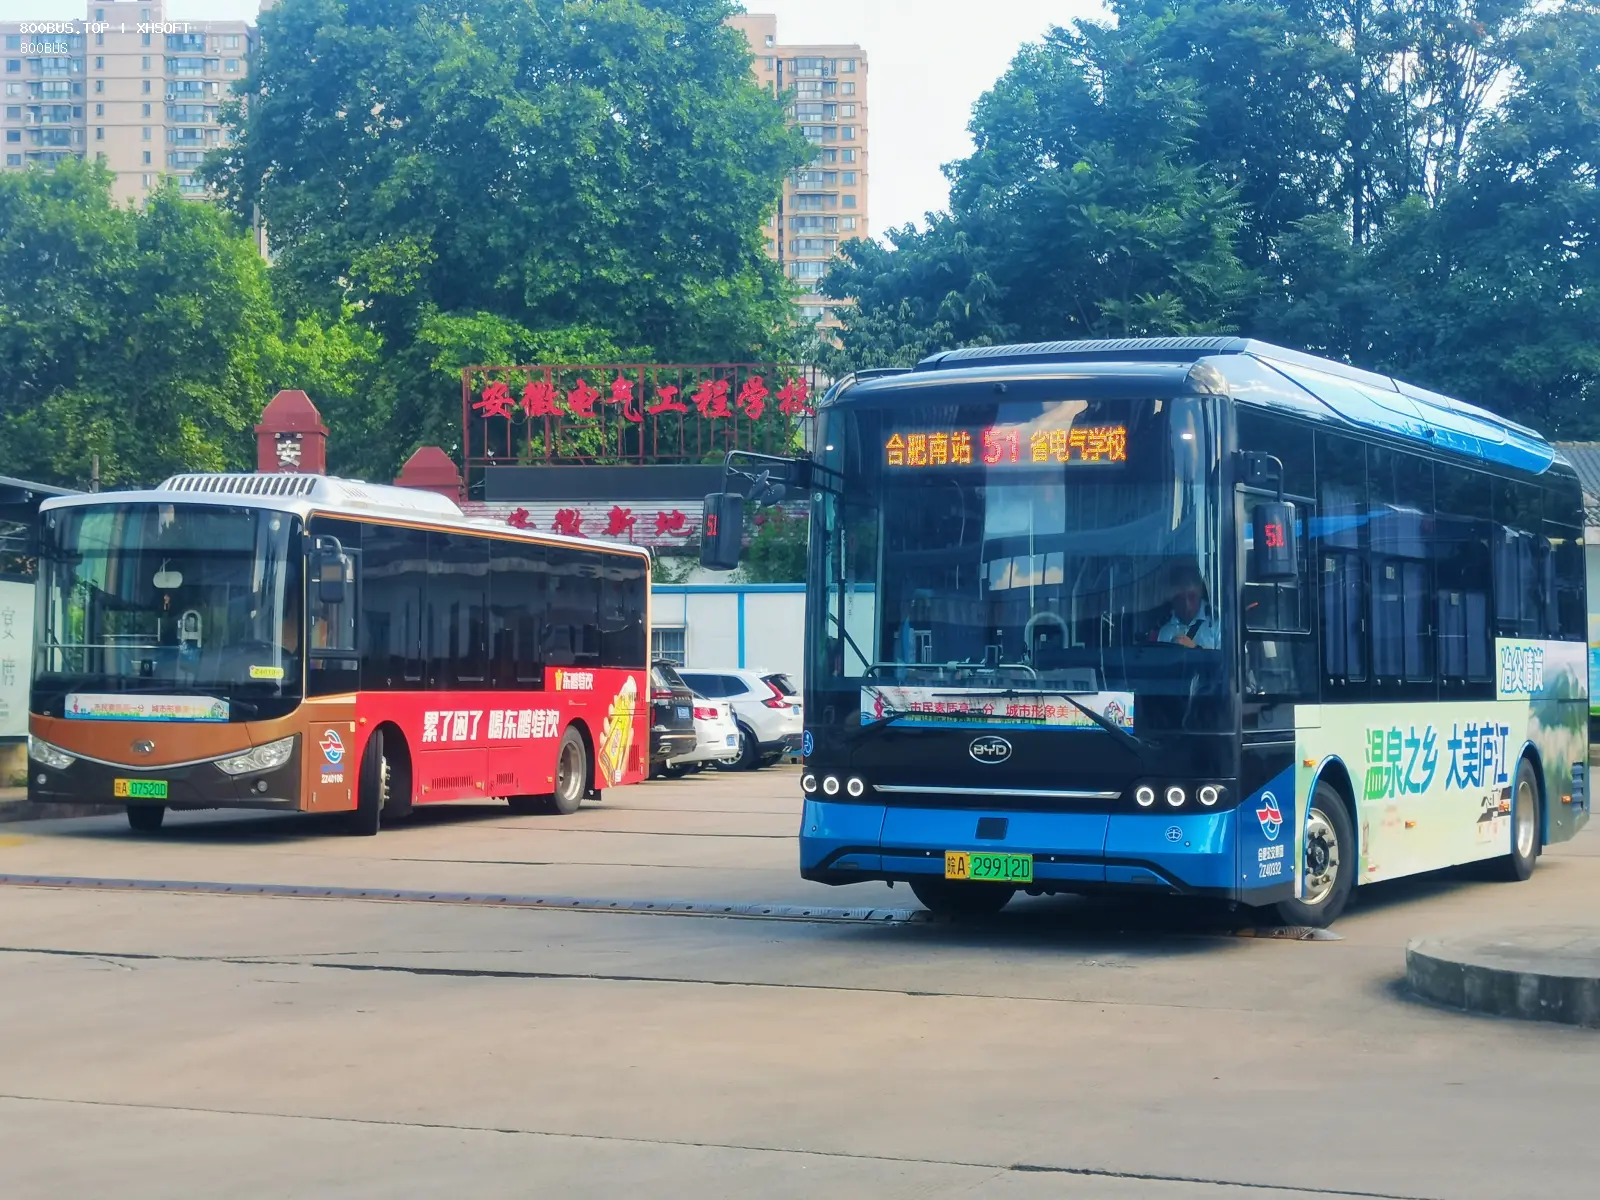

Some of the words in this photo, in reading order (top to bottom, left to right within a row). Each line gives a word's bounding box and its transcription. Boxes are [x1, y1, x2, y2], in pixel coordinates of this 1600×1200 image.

[472, 375, 816, 422] 安徽电气工程学校
[885, 431, 972, 466] 合肥南站
[983, 429, 1020, 463] 51
[1030, 424, 1127, 462] 省电气学校
[1264, 524, 1285, 547] 51
[422, 710, 483, 742] 累了困了
[487, 709, 560, 739] 喝东鹏特饮
[910, 702, 995, 716] 市民素质高分
[973, 744, 1007, 756] BYD
[1364, 725, 1439, 800] 温泉之乡
[1445, 721, 1510, 791] 大美庐江
